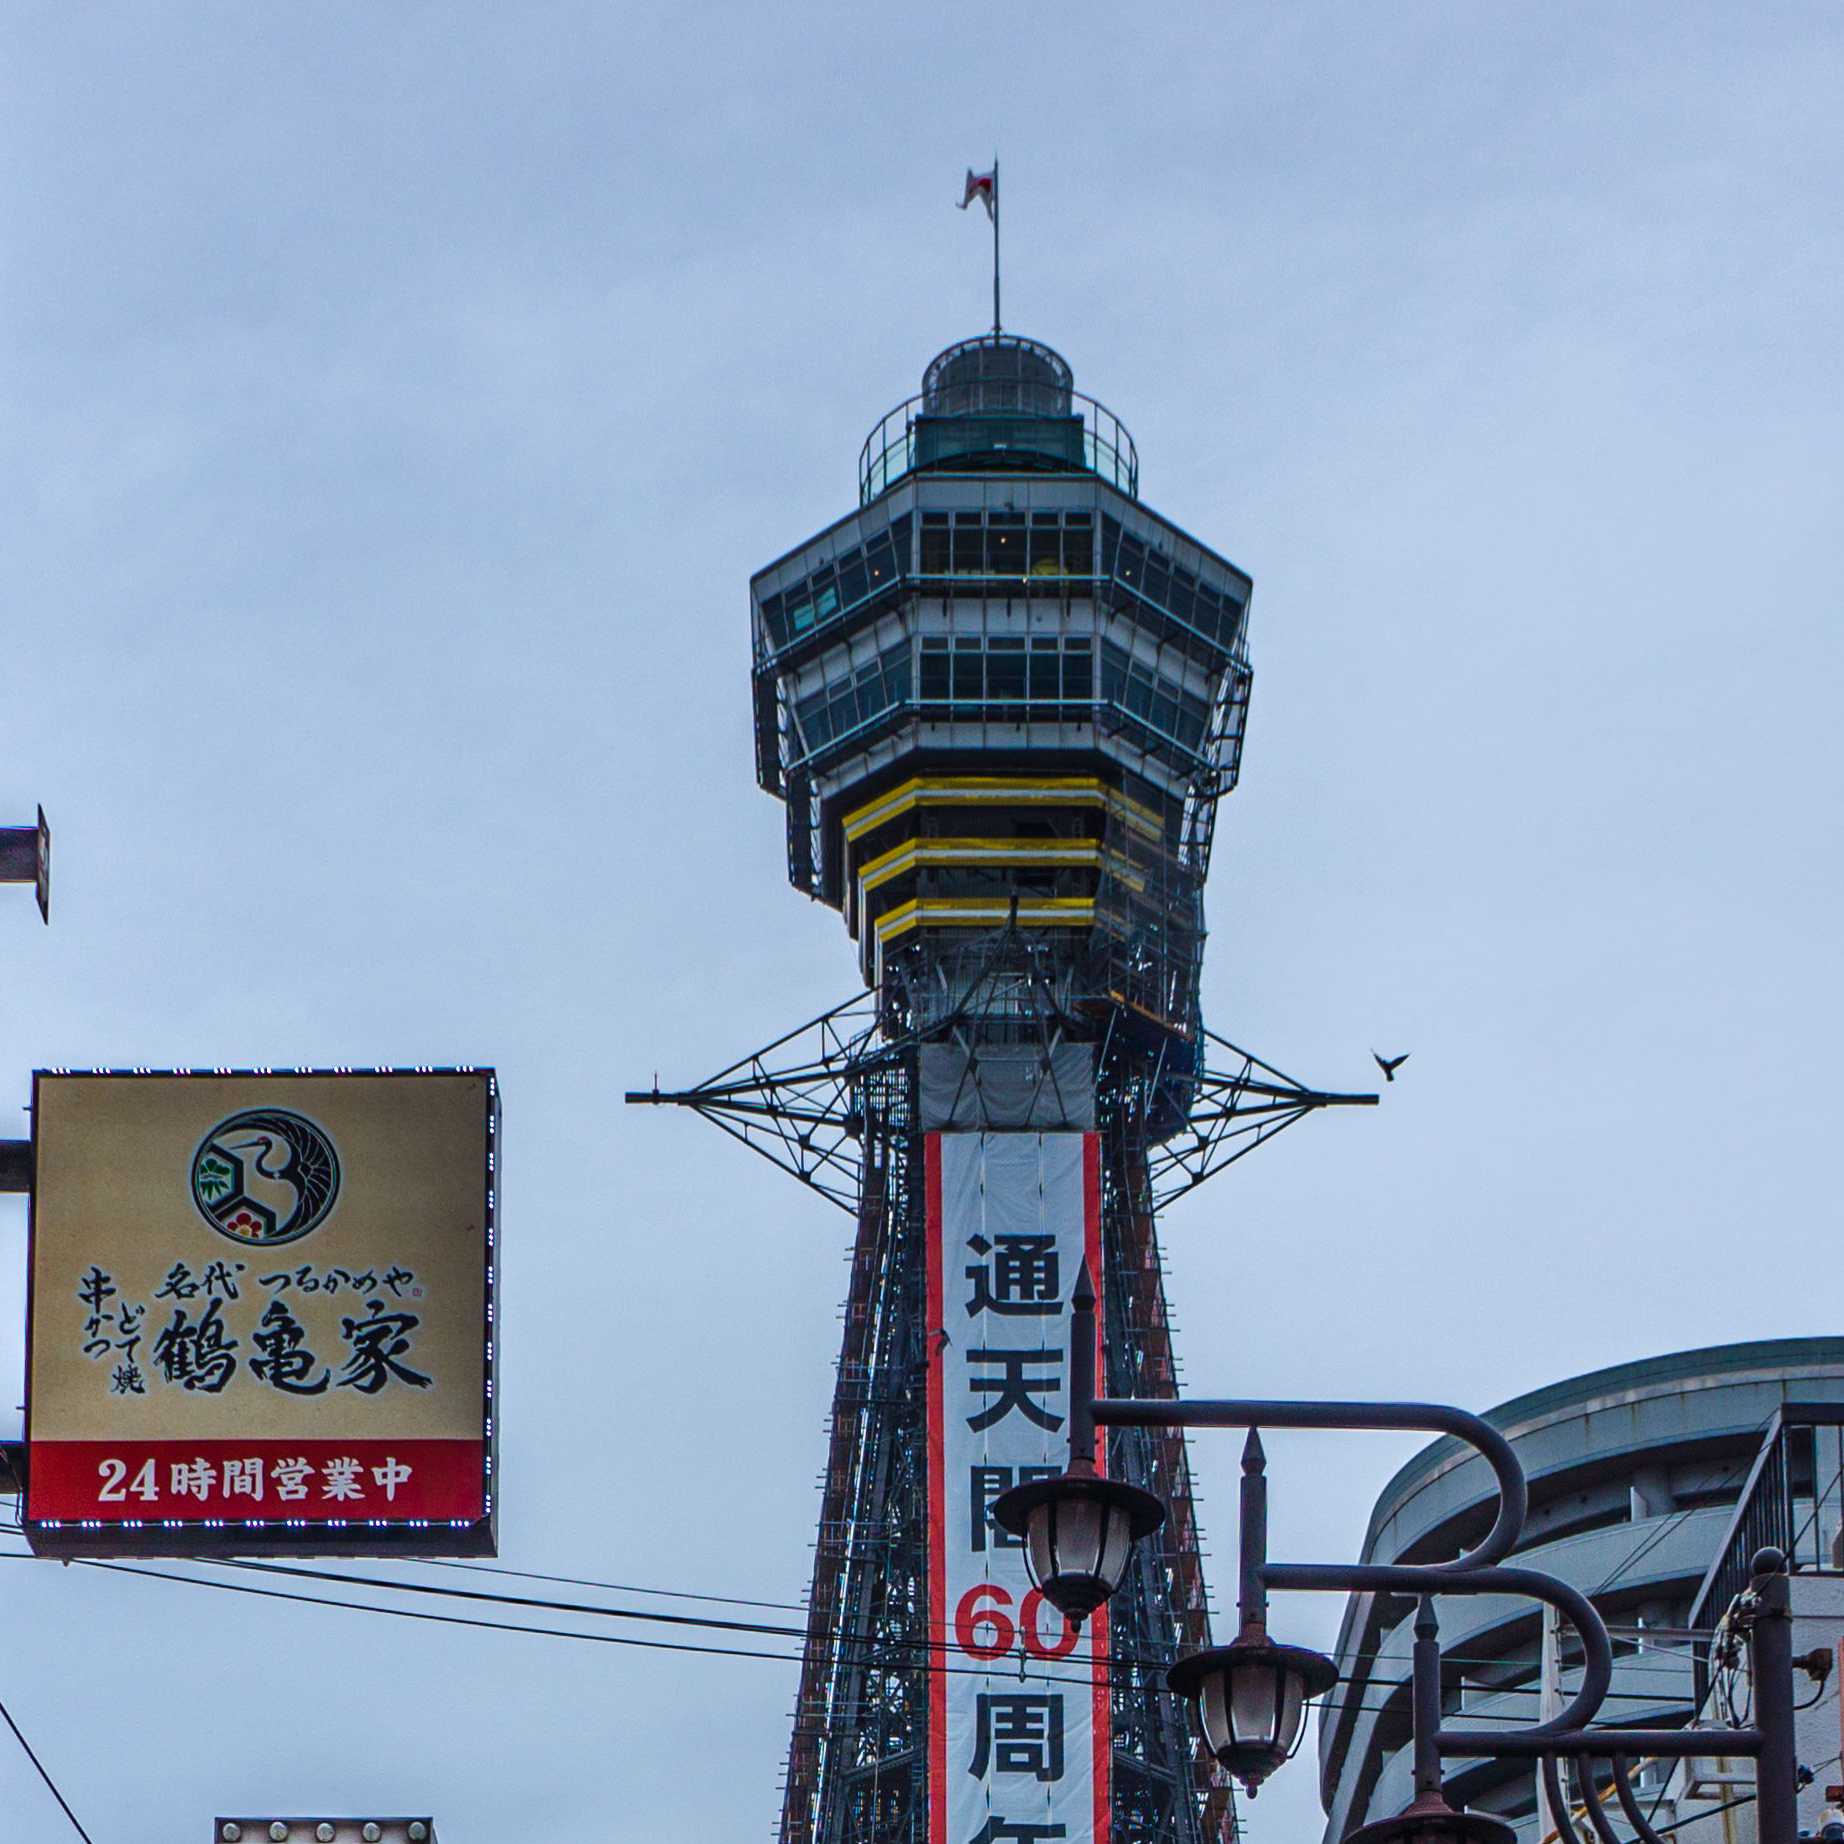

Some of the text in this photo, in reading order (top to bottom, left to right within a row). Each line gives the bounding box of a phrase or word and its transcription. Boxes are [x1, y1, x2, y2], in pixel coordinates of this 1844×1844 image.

[78, 1266, 117, 1359] 串かつ
[155, 1262, 414, 1302] 名代 つるかめや
[153, 1298, 434, 1396] 鶴亀家
[98, 1457, 414, 1502] 24時間営業中
